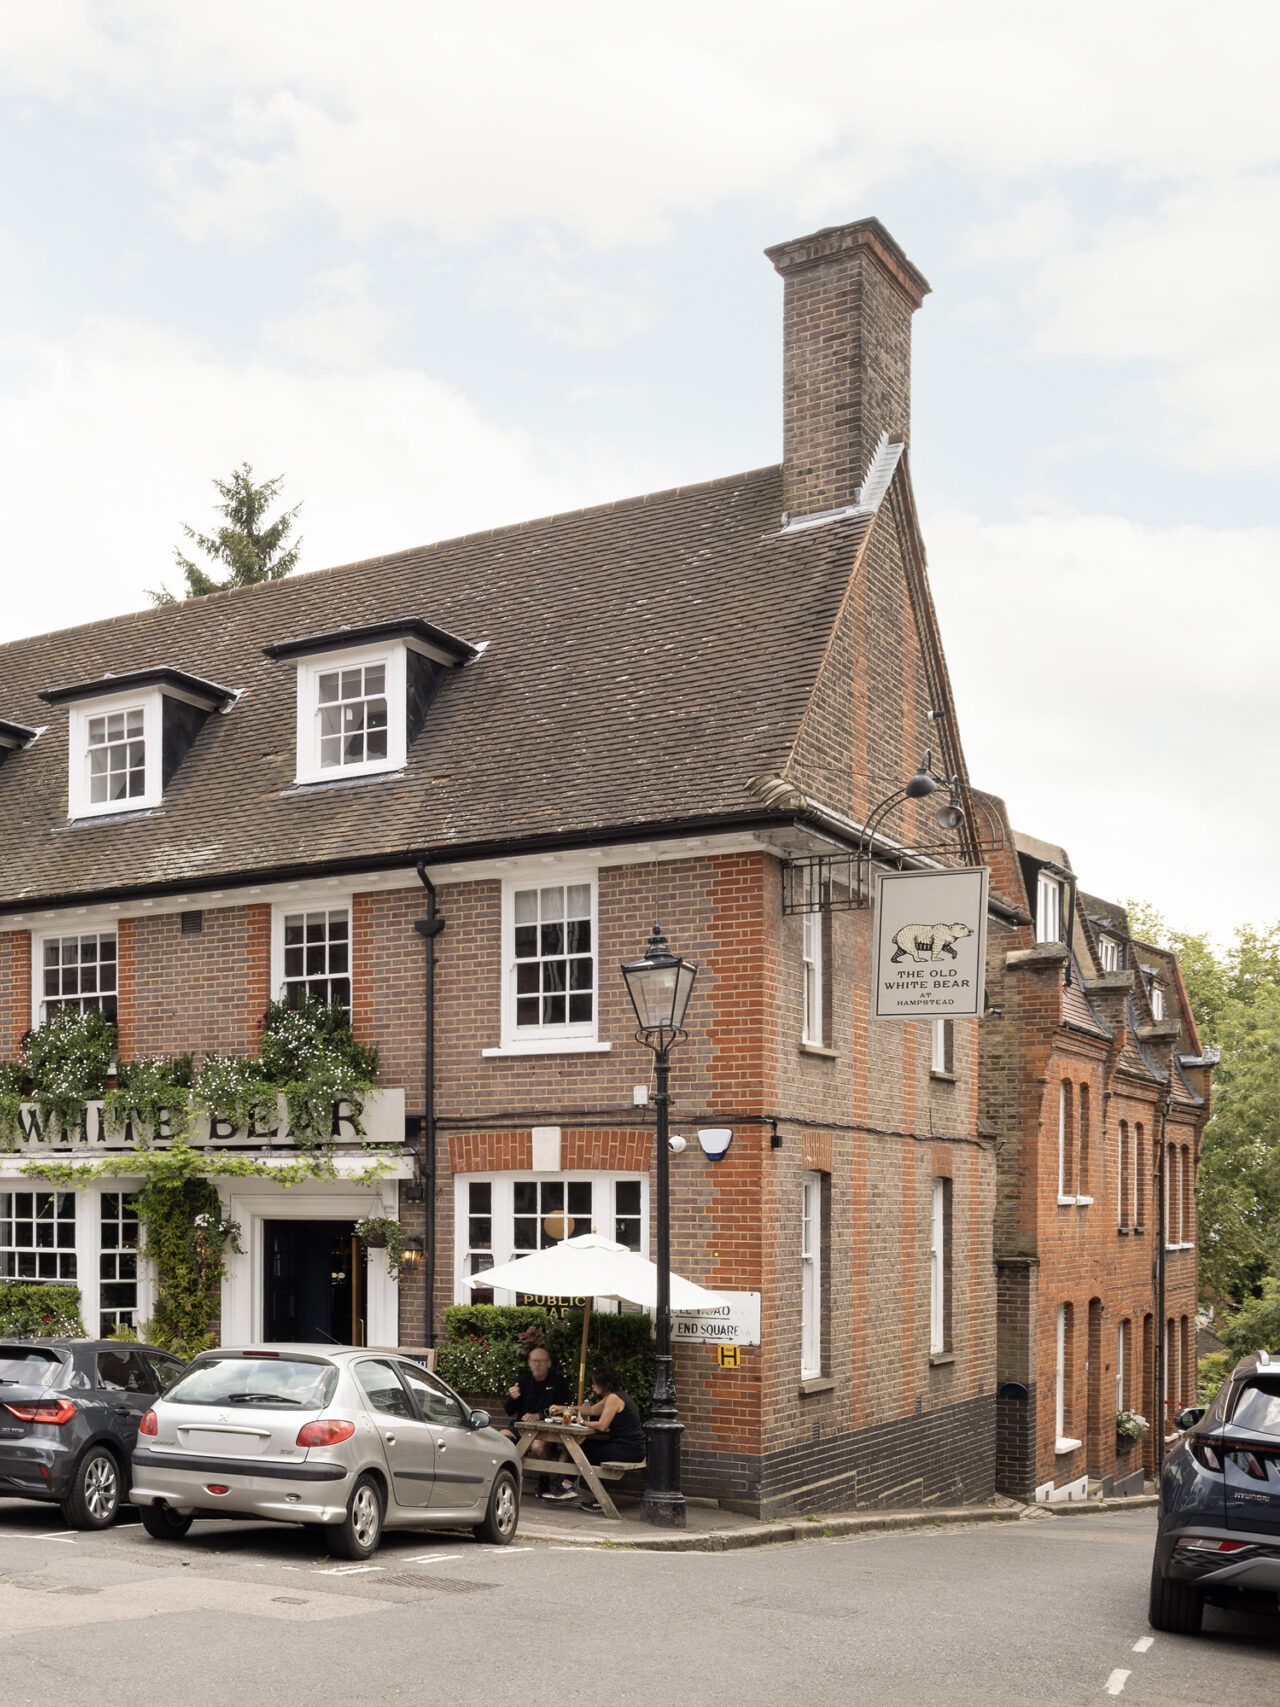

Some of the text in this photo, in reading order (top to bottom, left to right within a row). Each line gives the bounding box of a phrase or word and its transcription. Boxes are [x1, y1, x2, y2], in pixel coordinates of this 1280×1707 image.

[897, 969, 957, 978] THE OLD
[884, 980, 970, 989] WHITE BEAR
[524, 1294, 586, 1307] PUBLIC
[677, 1322, 698, 1335] END
[700, 1323, 739, 1337] SQUARE
[721, 1346, 737, 1366] H
